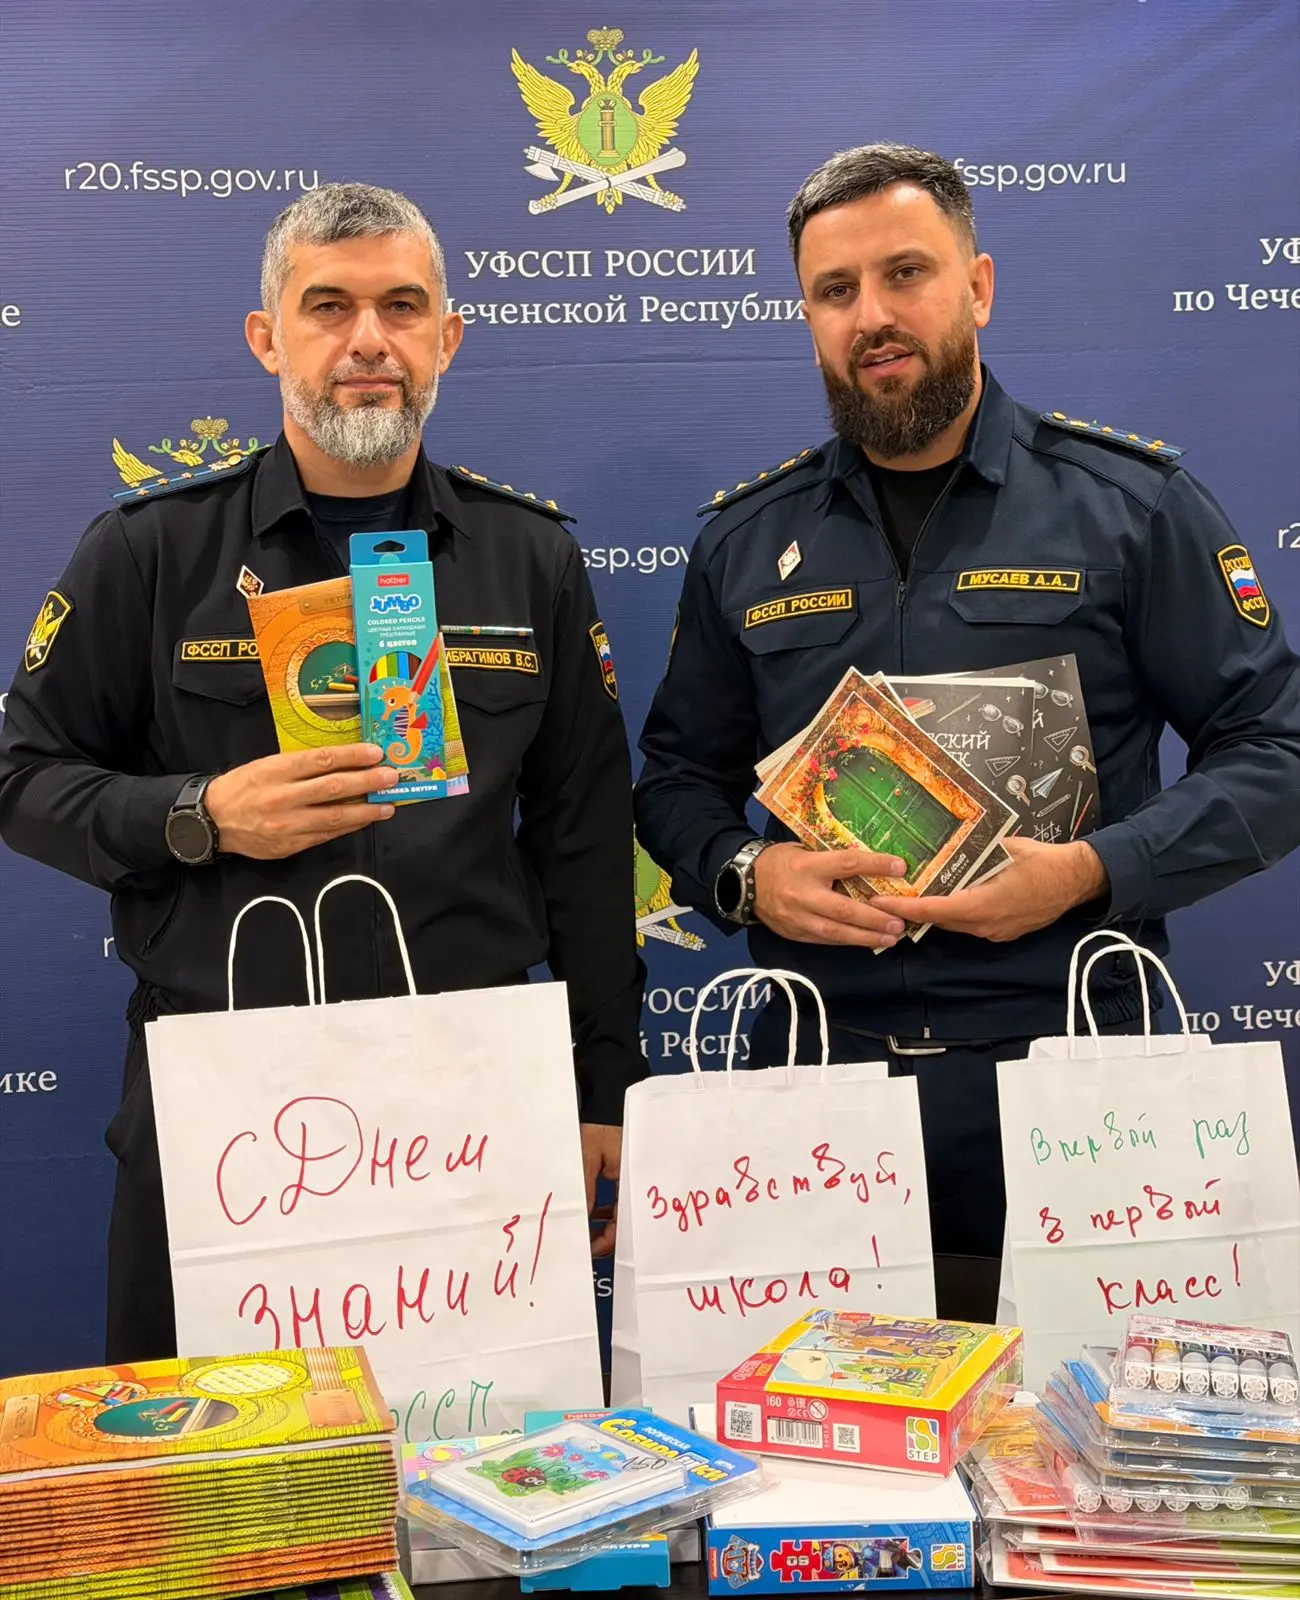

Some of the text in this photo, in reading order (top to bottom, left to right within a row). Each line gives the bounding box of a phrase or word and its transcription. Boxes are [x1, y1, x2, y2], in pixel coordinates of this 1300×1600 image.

[64, 161, 319, 198] r20.fssp.gov.ru
[464, 248, 757, 279] УФССП РОССИИ
[1172, 290, 1215, 312] по
[969, 572, 1068, 587] МУСАЕВ А.А.
[370, 593, 422, 614] JUMBO
[751, 593, 846, 621] ФССП РОССИИ
[367, 616, 426, 626] COLORED PENCILS
[187, 643, 231, 657] ФССП
[379, 640, 385, 648] 6
[516, 654, 535, 668] В.С.
[927, 730, 991, 750] СКИЙ
[642, 983, 772, 1014] ОССИИ
[1192, 1111, 1250, 1160] раз
[909, 1449, 938, 1462] STEP
[957, 1545, 965, 1569] STEP
